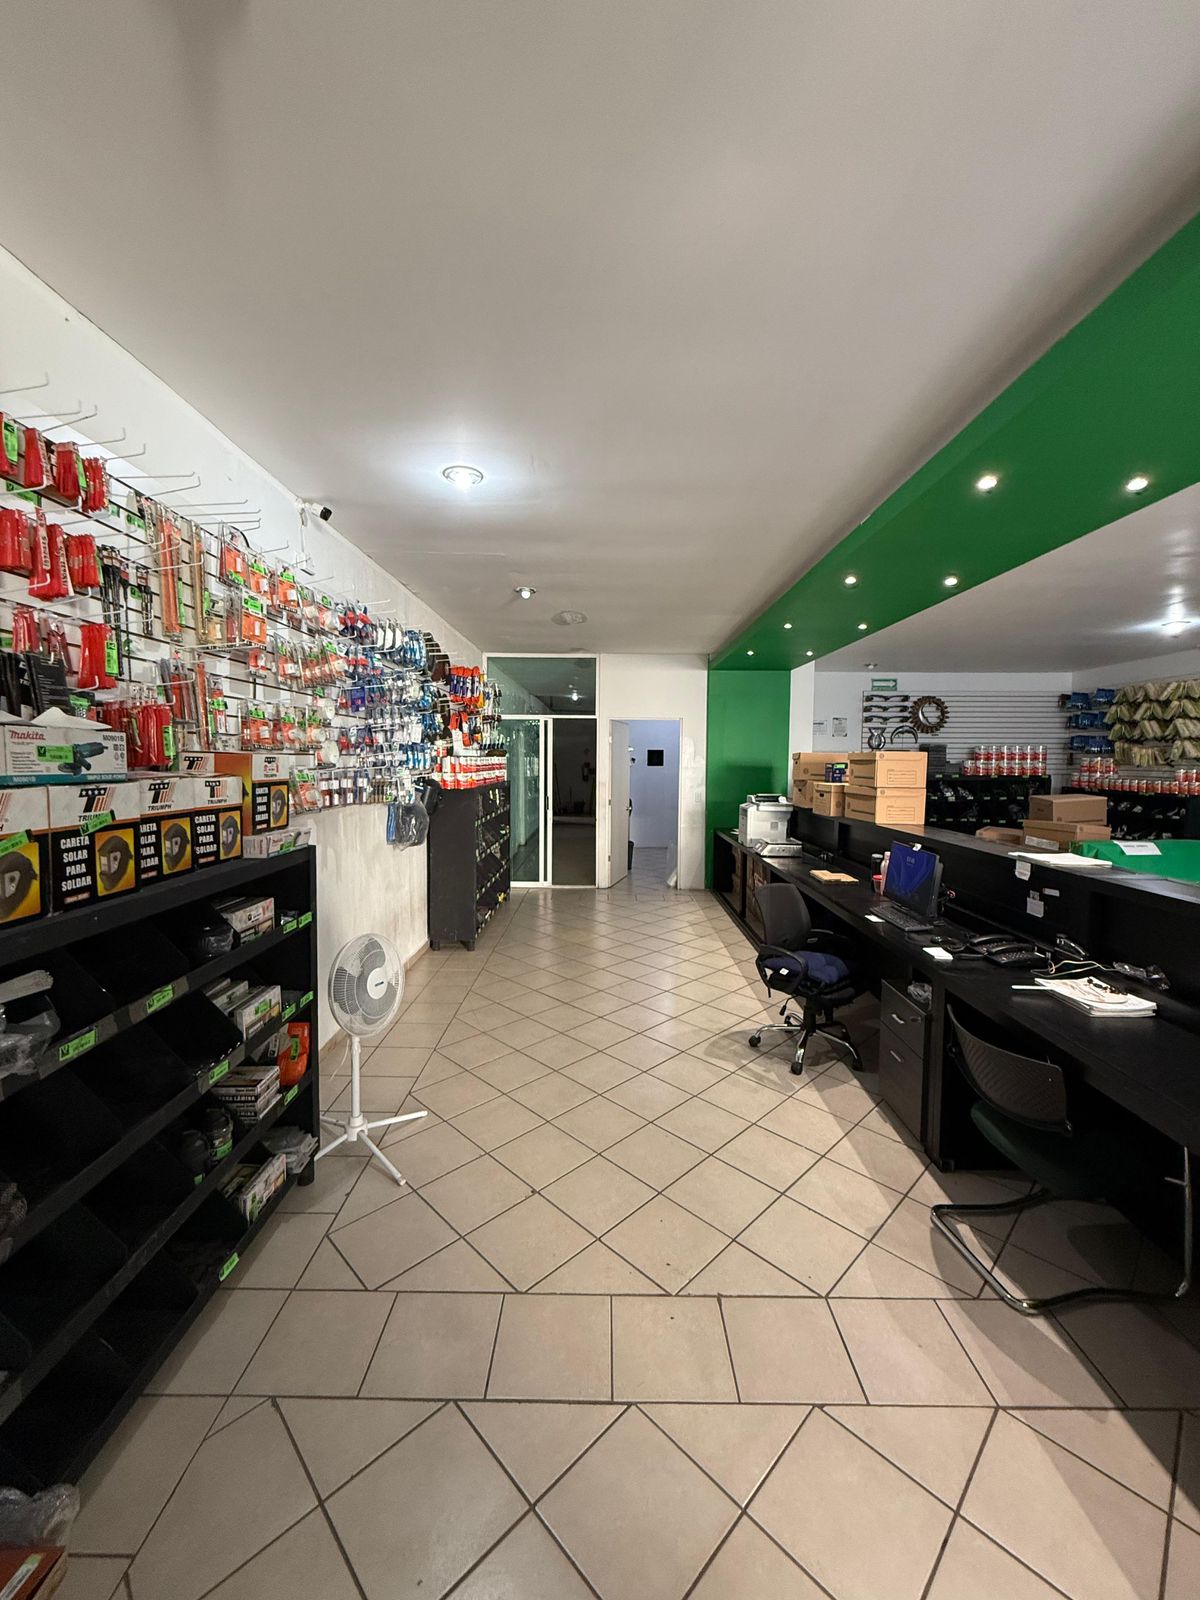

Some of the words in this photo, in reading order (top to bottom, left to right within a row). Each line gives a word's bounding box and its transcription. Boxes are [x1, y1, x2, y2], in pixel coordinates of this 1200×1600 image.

[194, 814, 216, 824] CARETA
[196, 824, 215, 834] SOLAR
[60, 836, 90, 849] CARETA
[198, 834, 214, 844] PARA
[195, 844, 217, 854] SOLDAR
[63, 849, 88, 863] SOLAR
[66, 863, 87, 877] PARA
[61, 876, 92, 892] SOLDAR
